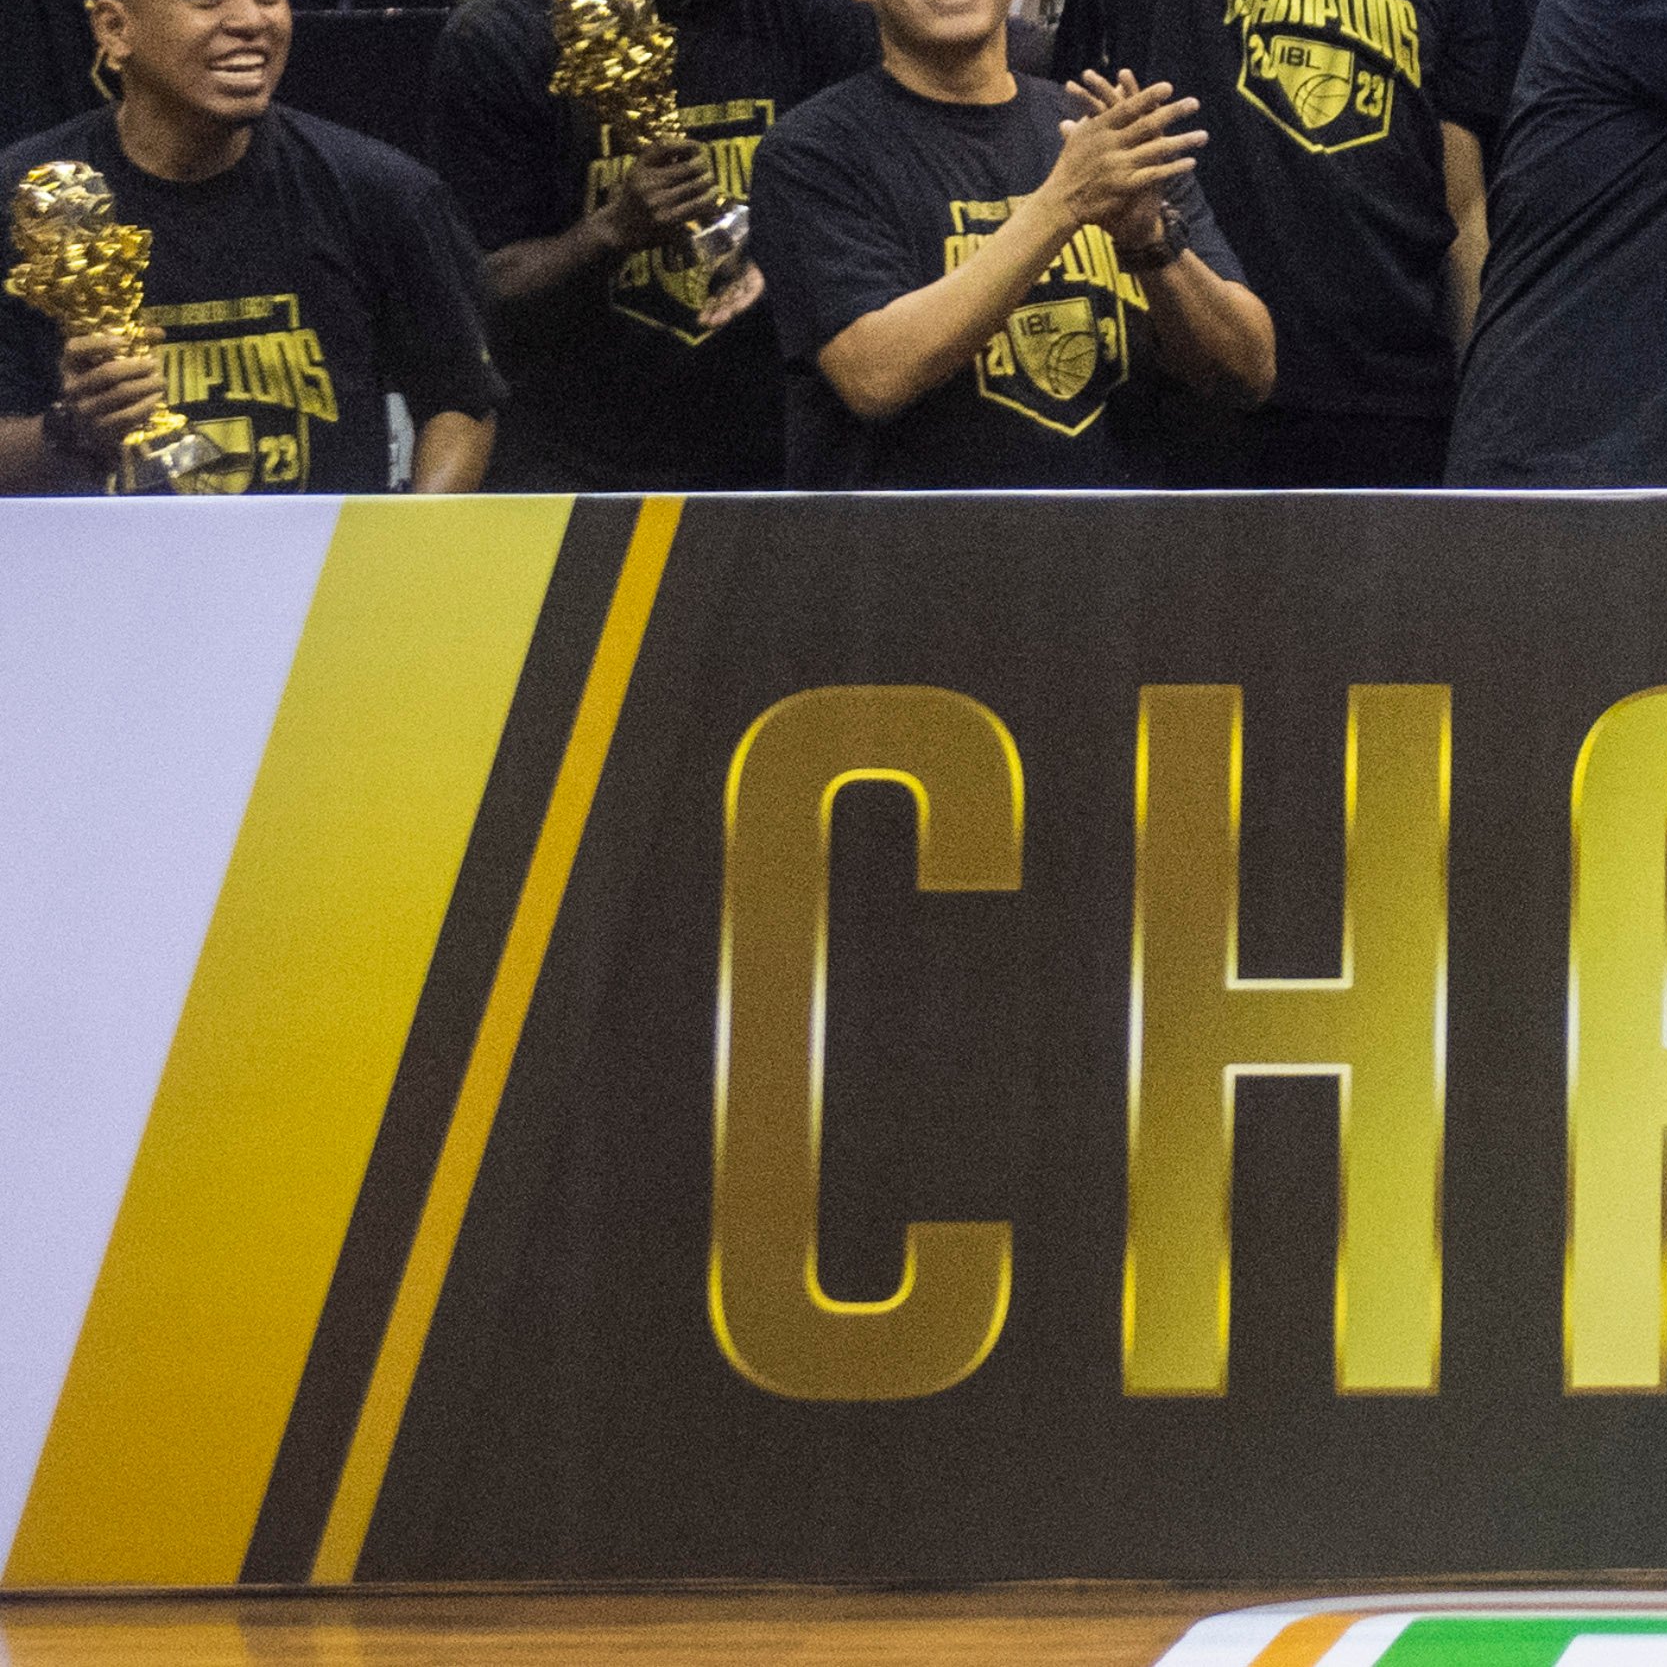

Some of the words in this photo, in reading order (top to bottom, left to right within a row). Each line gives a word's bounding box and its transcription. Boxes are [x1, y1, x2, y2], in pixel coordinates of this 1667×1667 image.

[1279, 45, 1321, 71] IBL
[1355, 70, 1385, 118] 23
[1017, 310, 1060, 340] IBL
[258, 433, 300, 483] 23
